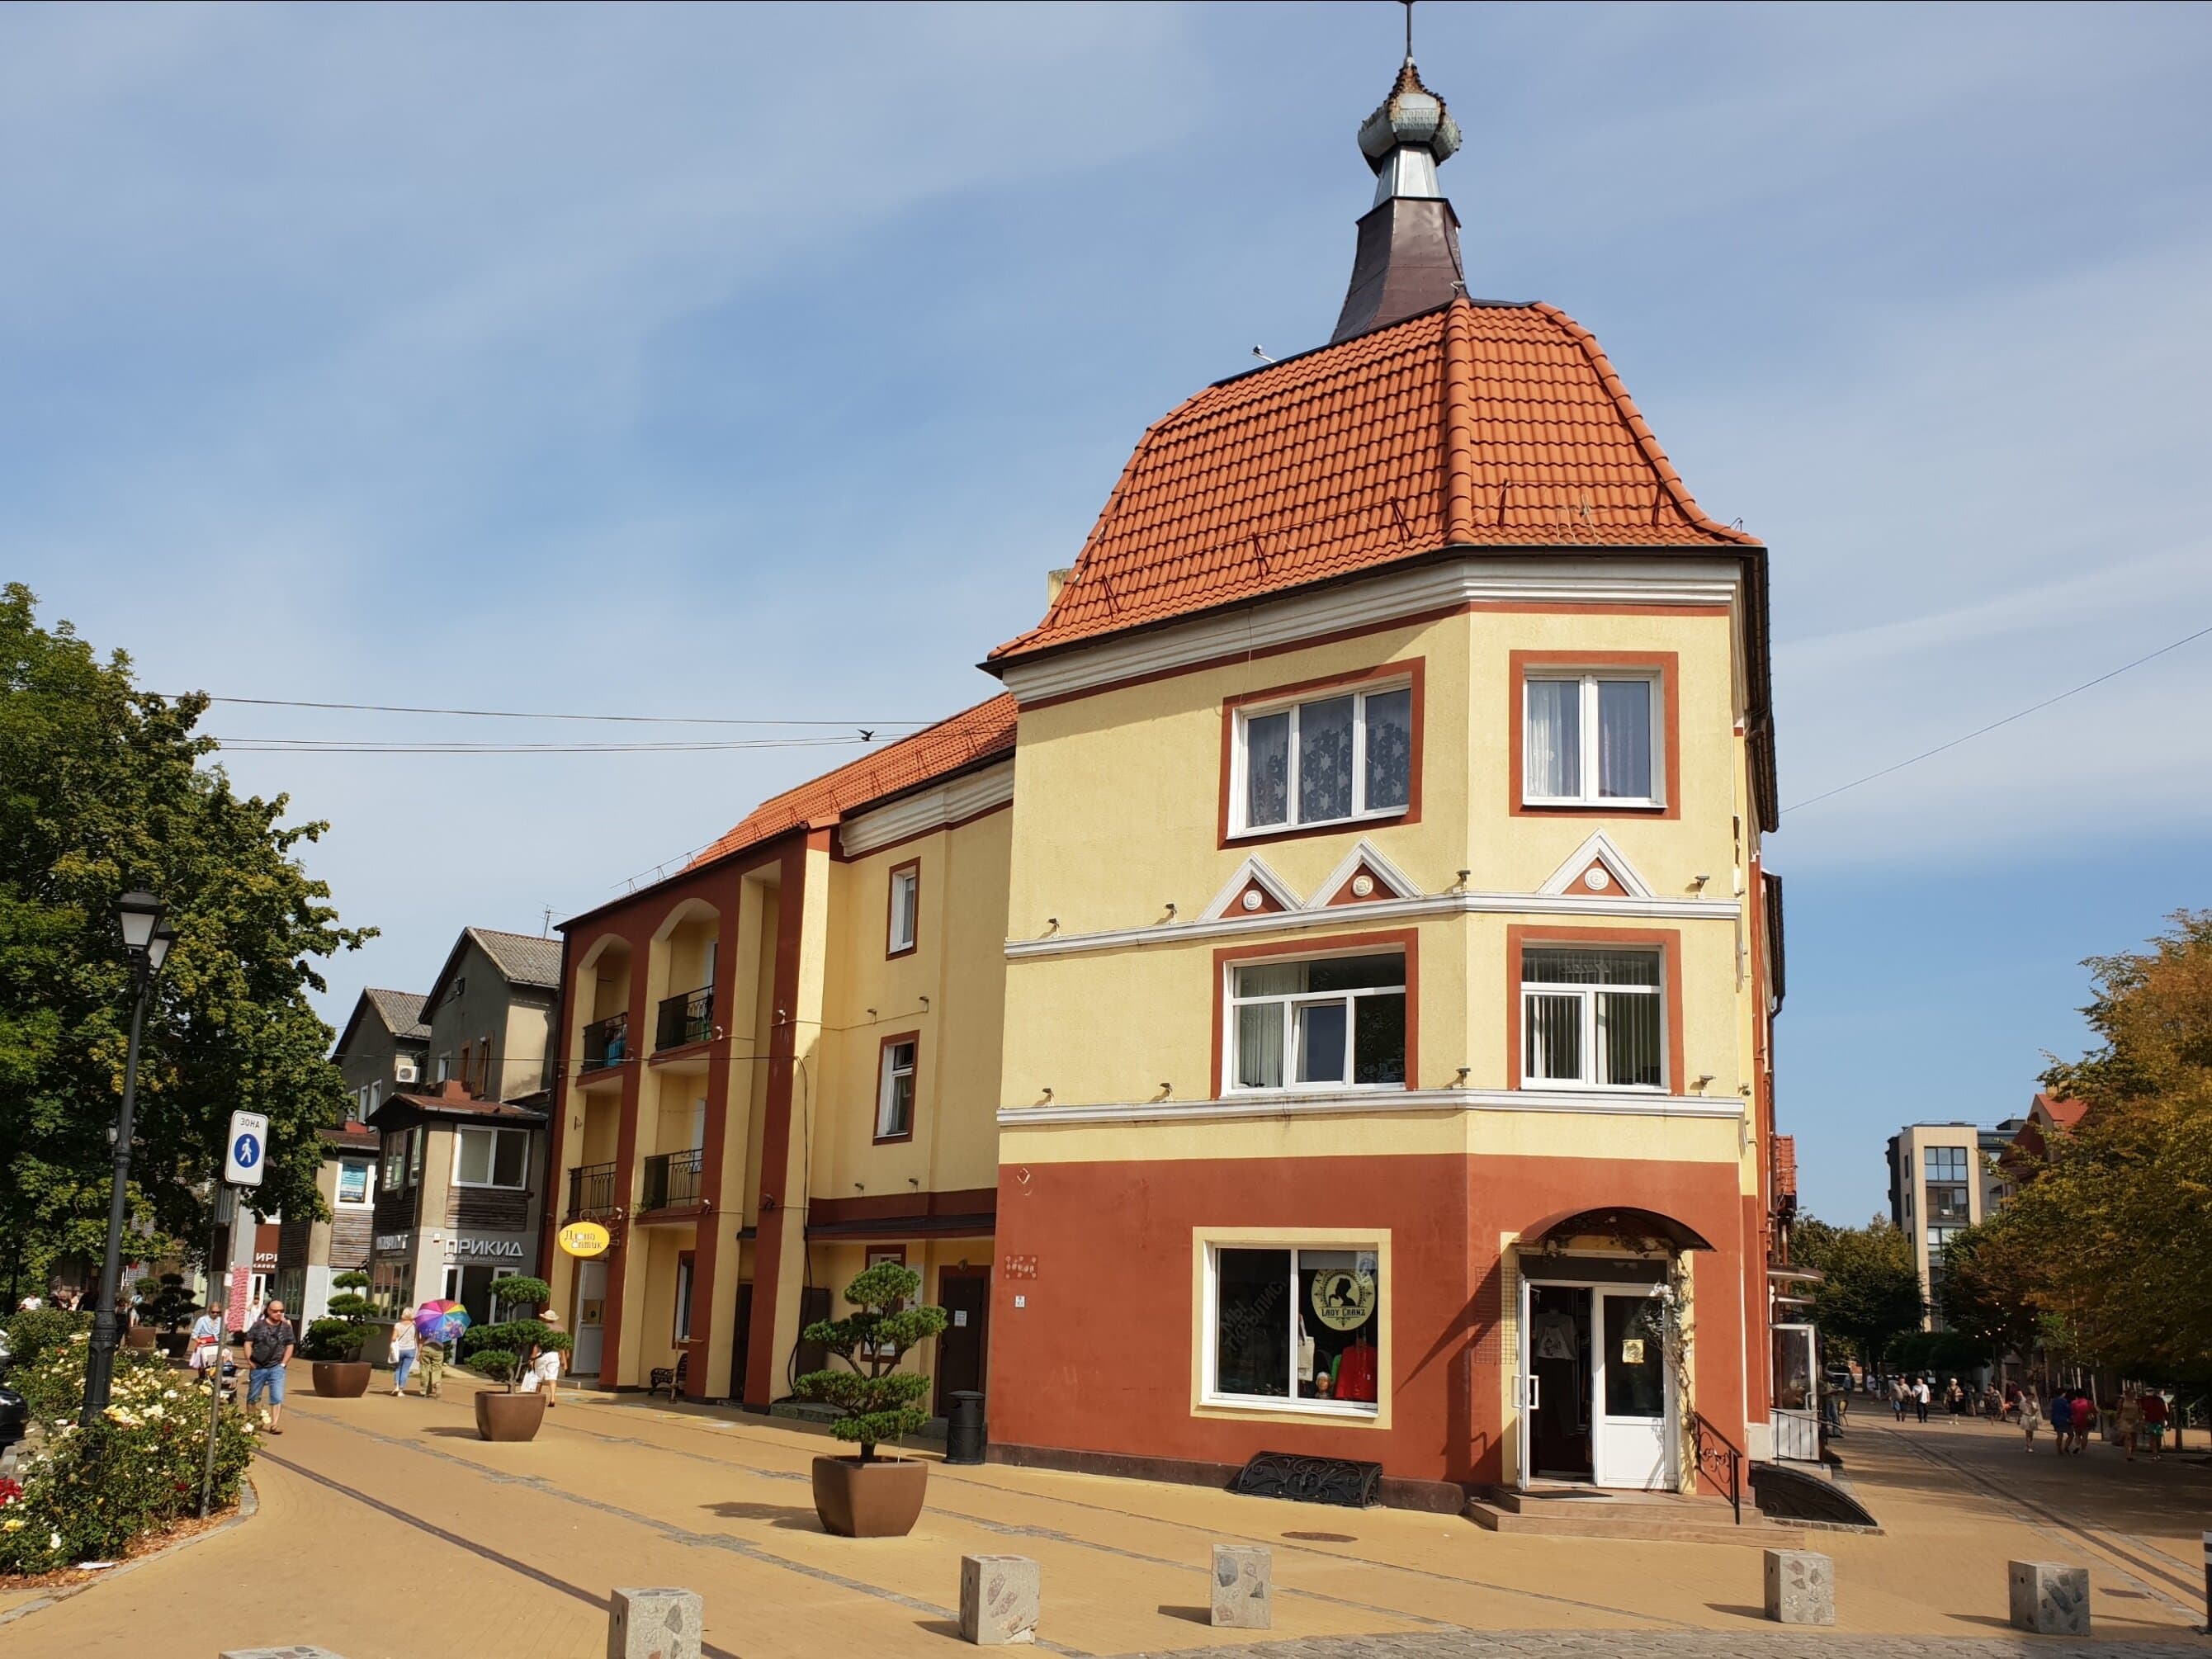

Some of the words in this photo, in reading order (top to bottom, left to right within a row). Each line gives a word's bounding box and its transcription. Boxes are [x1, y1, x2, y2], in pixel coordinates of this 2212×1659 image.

[240, 1117, 260, 1129] ЗОНА
[445, 1239, 524, 1257] ПРИКИД
[1321, 1307, 1339, 1316] LADY
